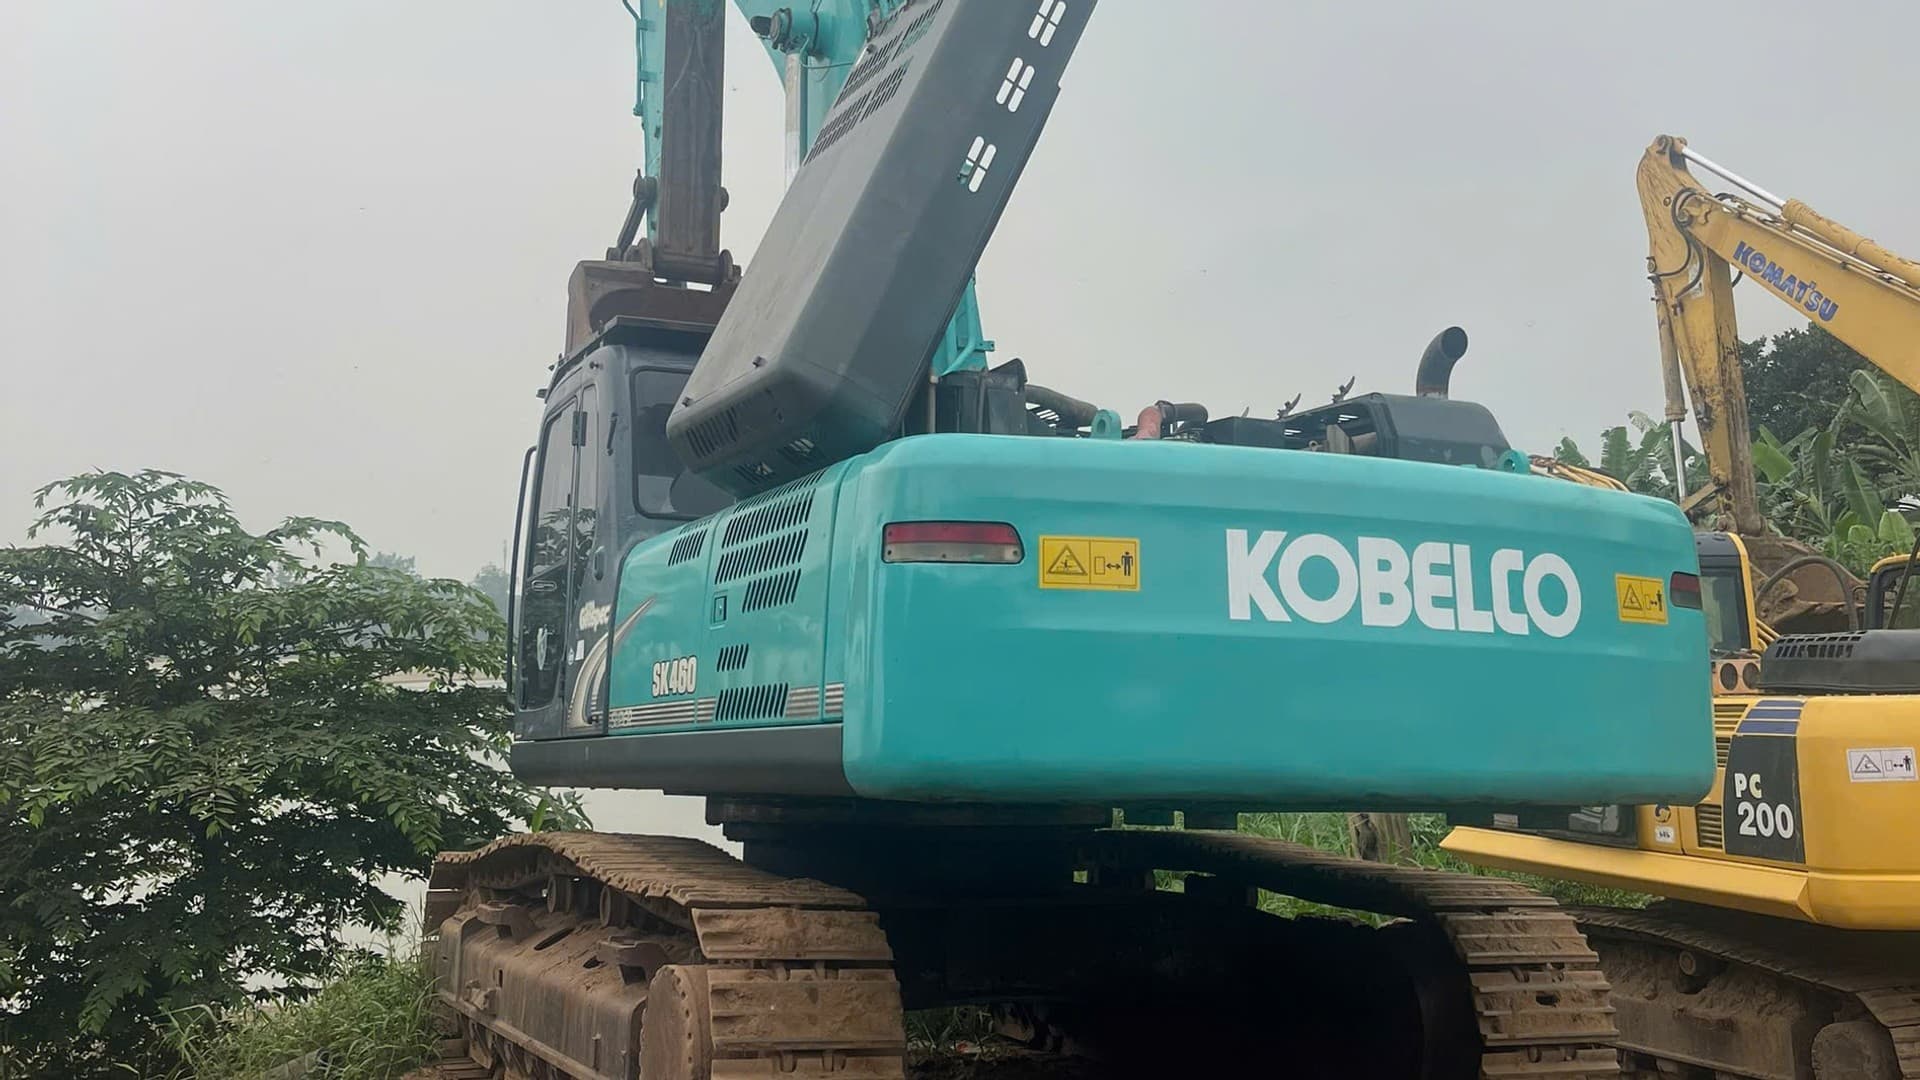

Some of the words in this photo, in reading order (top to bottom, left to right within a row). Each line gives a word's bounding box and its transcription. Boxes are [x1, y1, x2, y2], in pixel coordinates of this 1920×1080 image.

[1733, 240, 1839, 321] KOMATSU
[1226, 528, 1582, 638] KOBELCO
[1734, 773, 1762, 798] PC
[1737, 801, 1794, 839] 200
